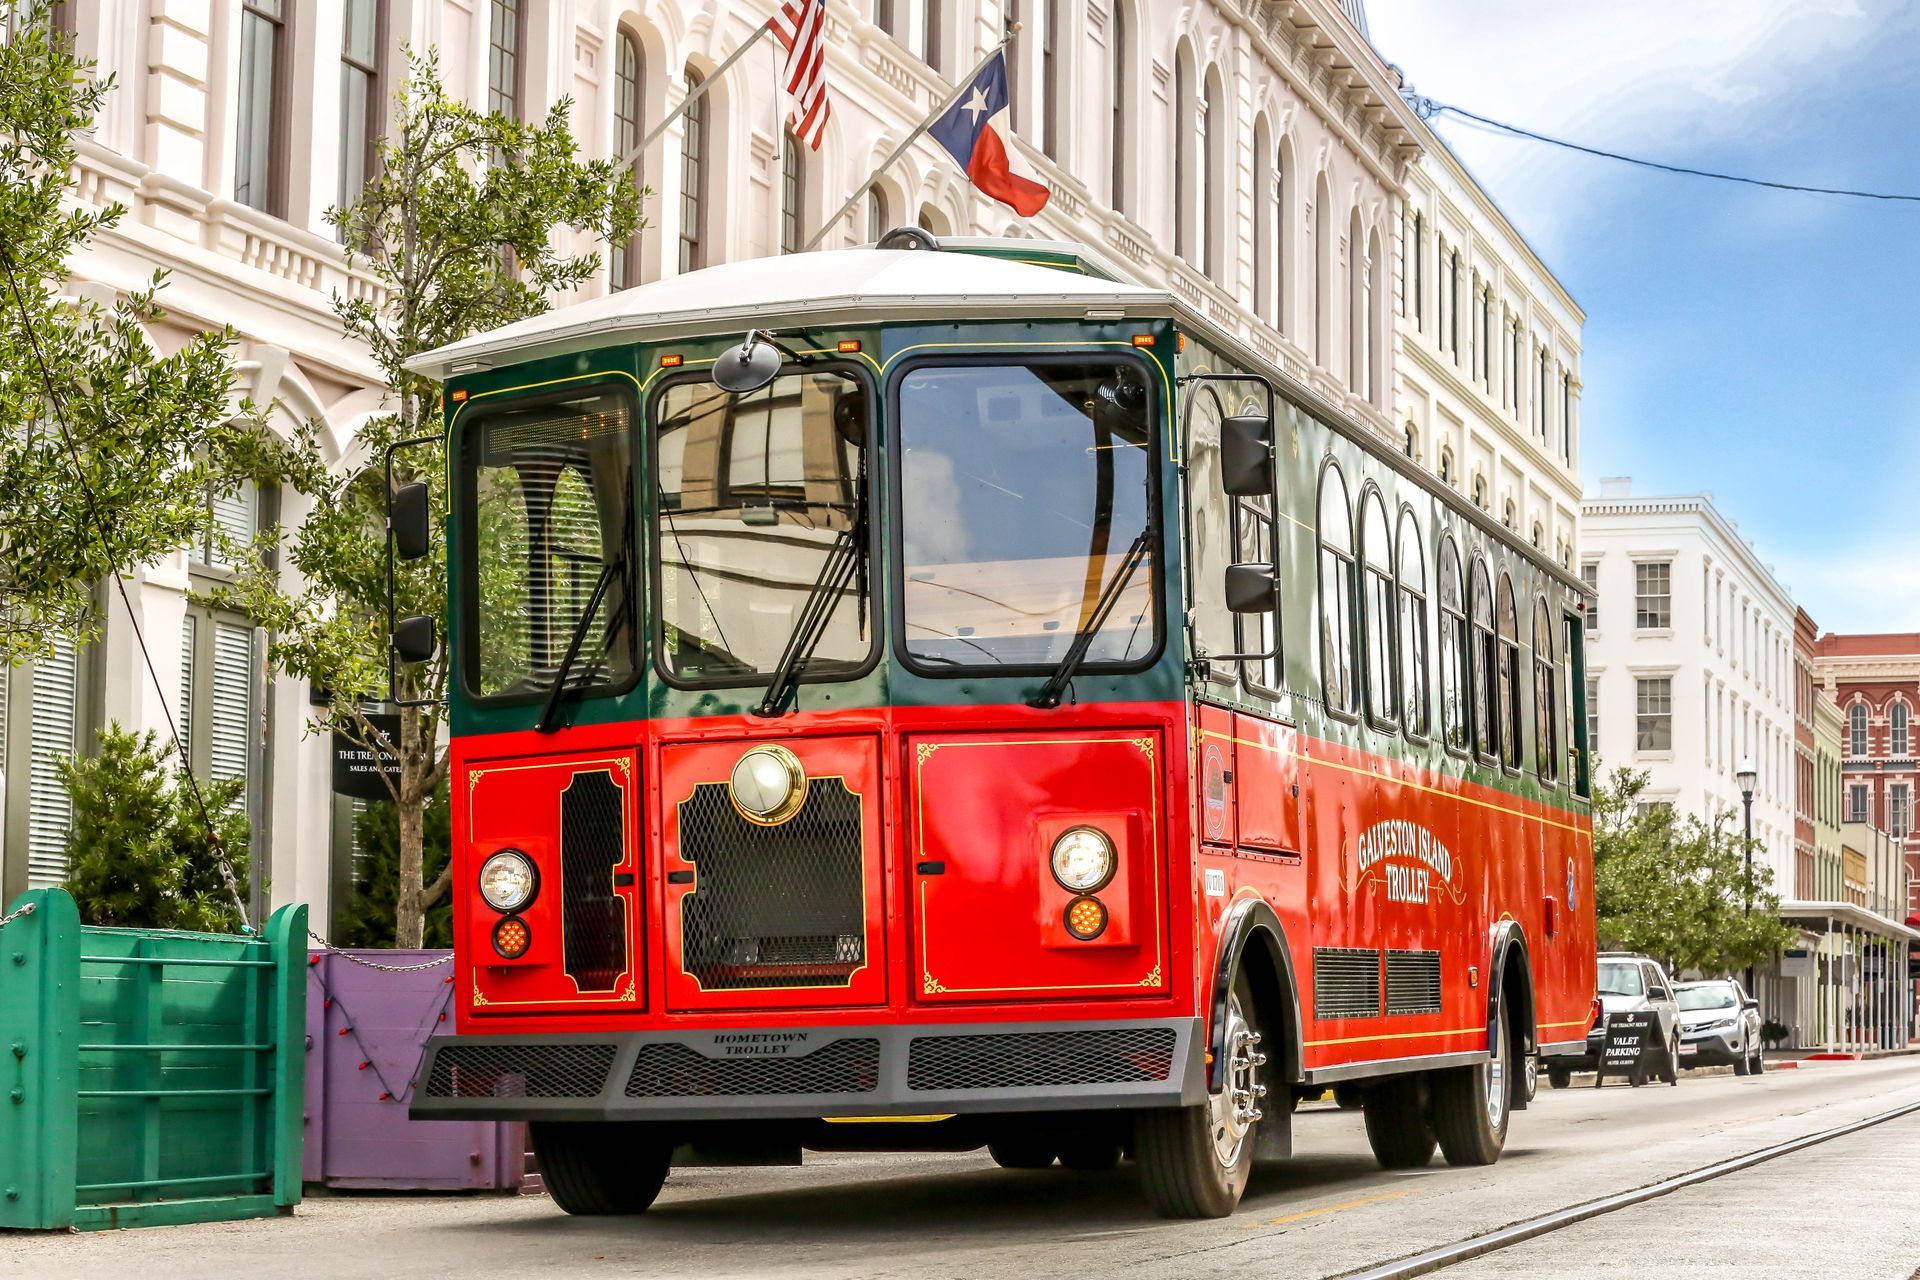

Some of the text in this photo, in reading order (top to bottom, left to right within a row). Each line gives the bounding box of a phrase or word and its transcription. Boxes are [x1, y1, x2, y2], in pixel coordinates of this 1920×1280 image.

[338, 750, 397, 760] THE TREON
[1358, 819, 1451, 884] GALVESTON ISLAND
[1385, 864, 1429, 904] TROLLEY
[713, 1032, 808, 1044] HOMETOWN
[1613, 1036, 1640, 1046] VALET
[725, 1044, 790, 1055] TROLLEY
[1605, 1047, 1641, 1057] PARKING
